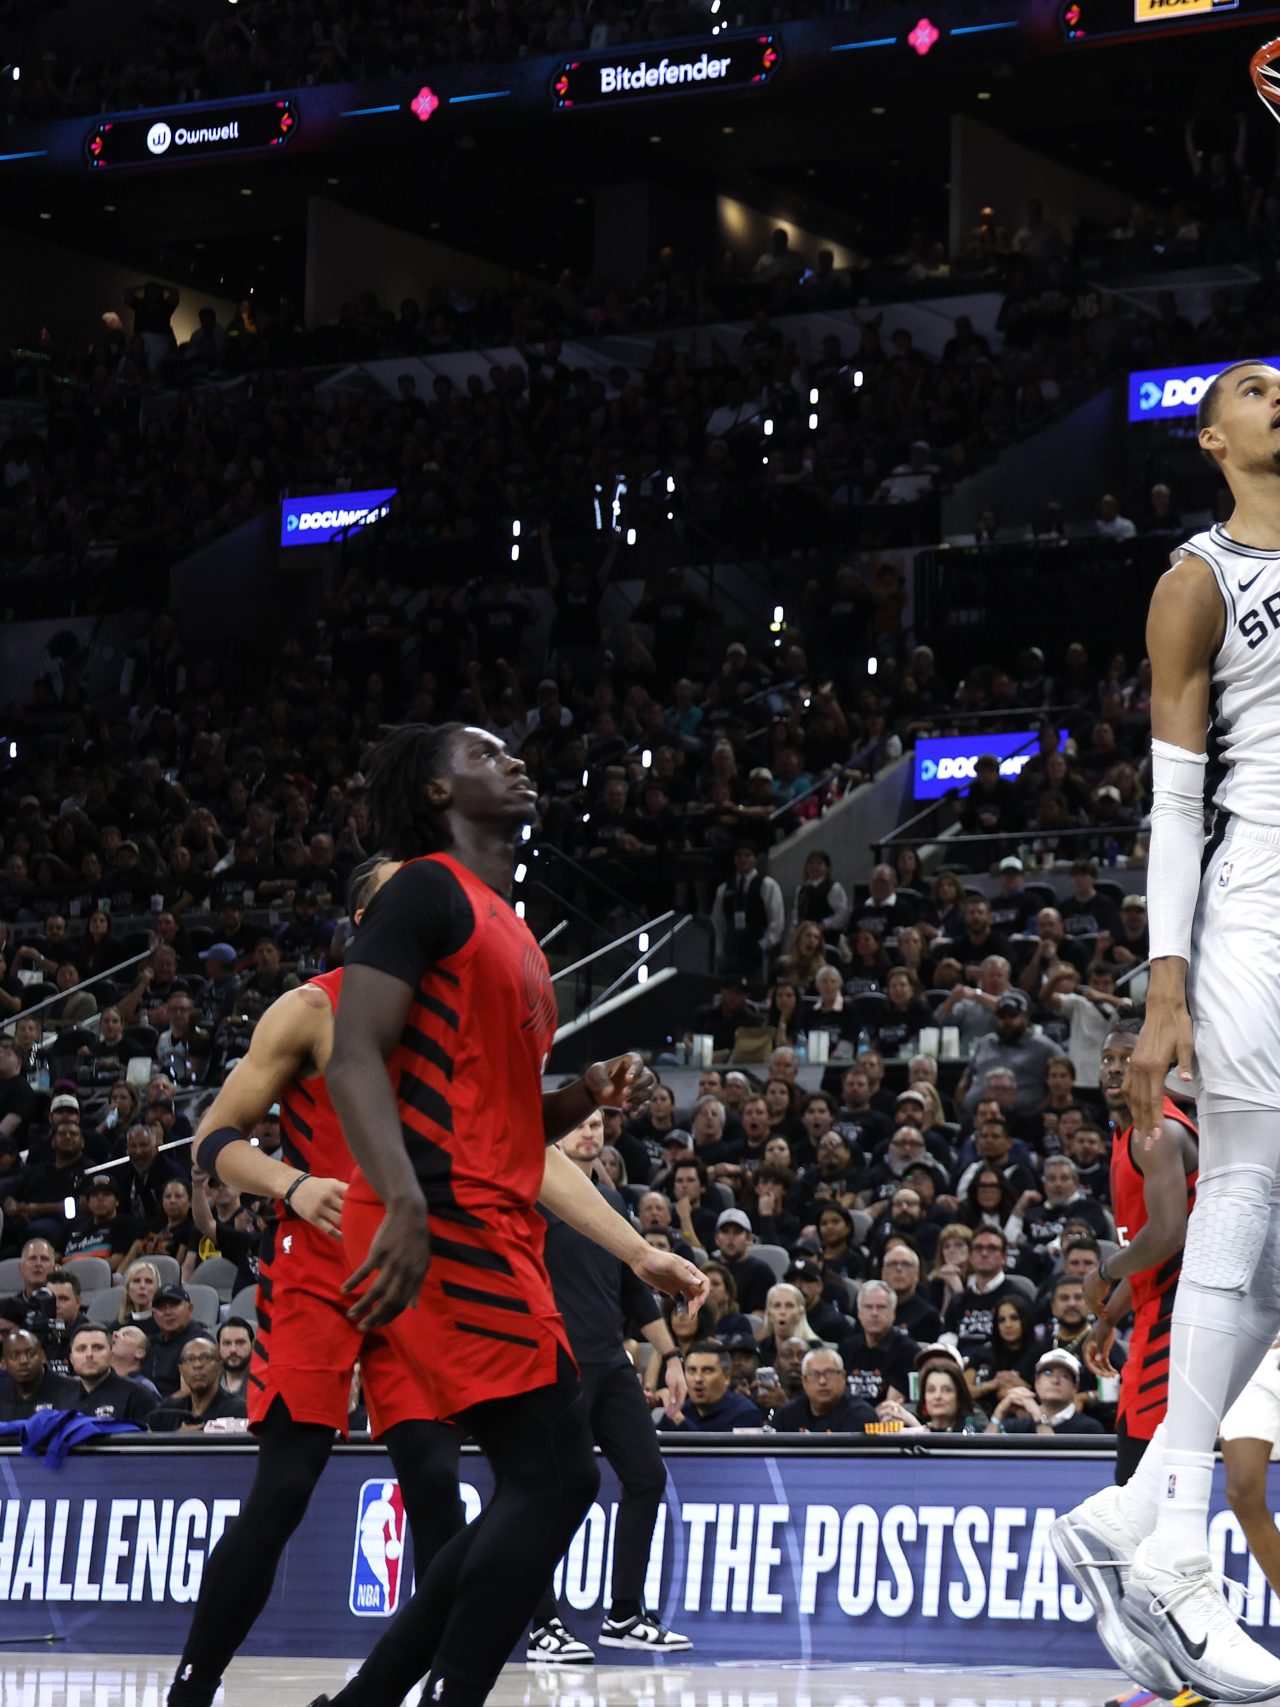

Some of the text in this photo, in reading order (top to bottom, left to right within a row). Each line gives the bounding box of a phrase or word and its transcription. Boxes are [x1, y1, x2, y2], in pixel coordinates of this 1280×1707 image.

[600, 53, 731, 93] Bitdefender
[174, 121, 239, 146] Ownwell
[682, 1503, 789, 1613] THE
[357, 1583, 380, 1607] NBA
